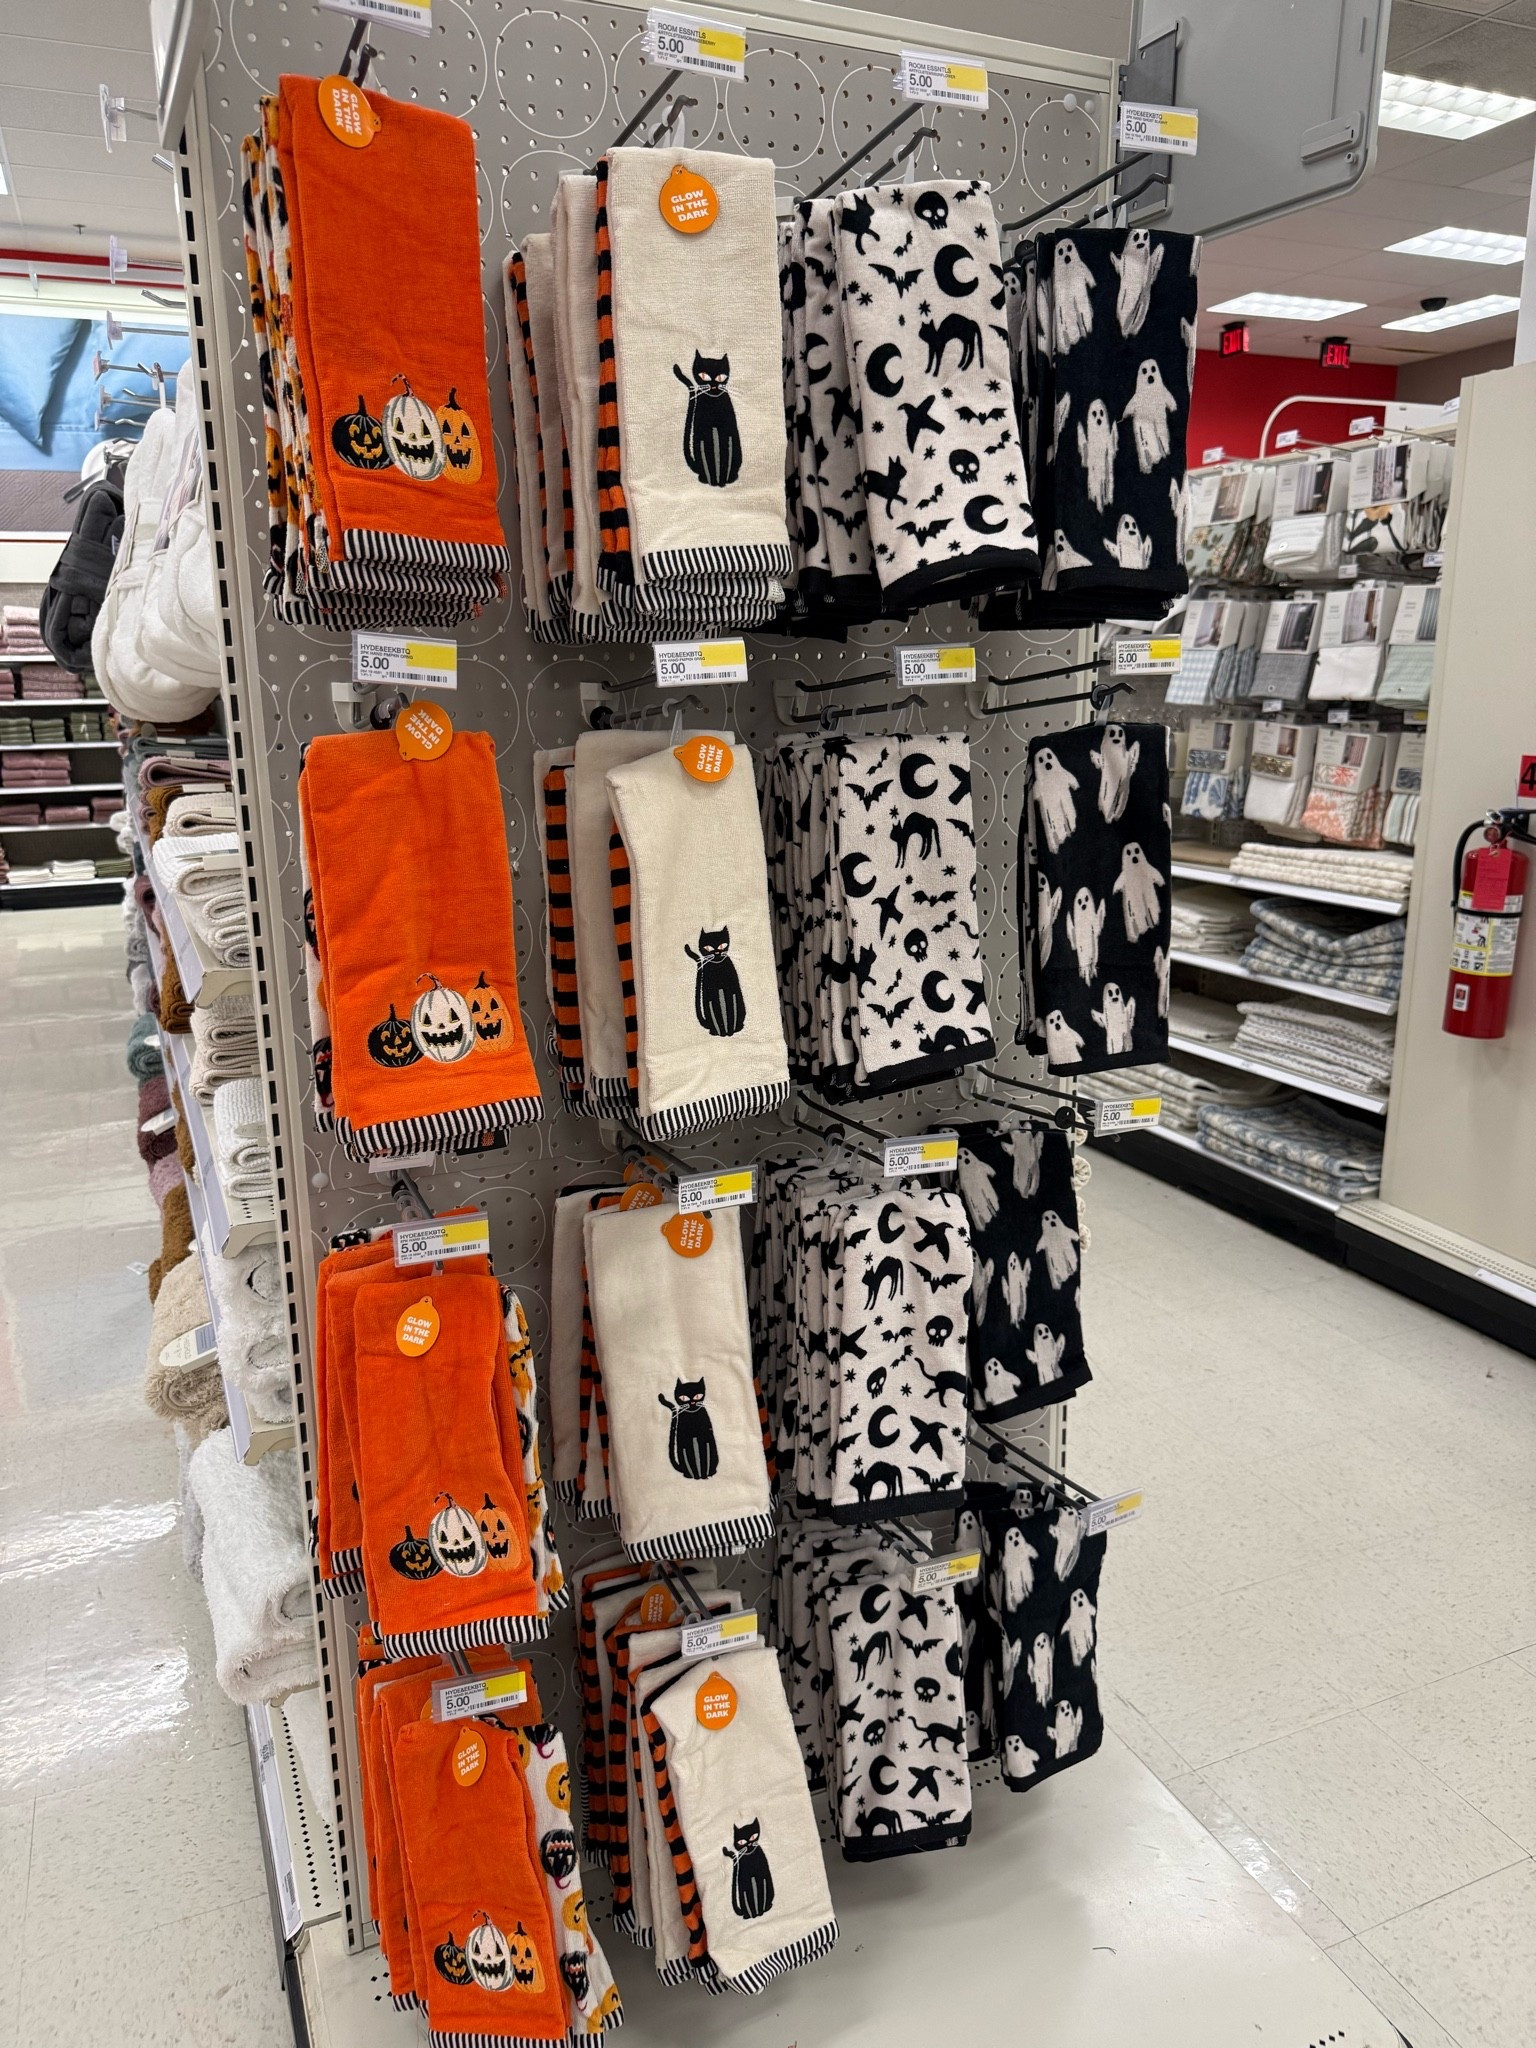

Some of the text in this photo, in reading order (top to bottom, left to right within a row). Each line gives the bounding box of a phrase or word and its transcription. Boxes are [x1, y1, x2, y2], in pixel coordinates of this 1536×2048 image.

[658, 23, 706, 39] ROOM ESSNTLS
[658, 36, 683, 53] 5.00
[927, 65, 951, 74] ESSNTLS
[909, 74, 932, 88] 5.00
[333, 89, 344, 127] DARK
[342, 88, 353, 134] IN THE
[351, 93, 362, 135] GLOW
[1126, 120, 1146, 133] 5.00
[671, 190, 704, 203] GLOW
[672, 199, 709, 213] IN THE
[678, 208, 709, 222] DARK
[1326, 344, 1349, 366] EXIT
[360, 644, 410, 654] HYDE&EEKBTQ
[361, 656, 389, 670] 5.00
[1119, 653, 1137, 663] 5.00
[661, 663, 685, 674] 5.00
[905, 664, 925, 674] 5.00
[418, 709, 444, 735] DARK
[410, 714, 440, 744] IN THE
[405, 723, 432, 749] GLOW
[697, 744, 707, 770] GLOW
[705, 744, 715, 773] IN THE
[714, 749, 723, 772] DARK
[1103, 1112, 1120, 1121] 5.00
[889, 1156, 909, 1166] 5.00
[681, 1191, 702, 1204] 5.00
[400, 1229, 446, 1239] HYDE&EEKBTQ
[681, 1220, 689, 1246] GLOW
[695, 1224, 704, 1248] DARK
[401, 1241, 427, 1253] 5.00
[688, 1240, 693, 1249] IN
[408, 1317, 432, 1328] GLOW
[414, 1327, 430, 1337] THE
[403, 1334, 424, 1345] DARK
[918, 1573, 937, 1583] 5.00
[687, 1636, 707, 1647] 5.00
[446, 1696, 469, 1709] 5.00
[704, 1694, 729, 1702] GLOW
[714, 1701, 730, 1709] THE
[706, 1710, 728, 1719] DARK
[458, 1743, 478, 1759] GLOW
[458, 1751, 480, 1768] IN THE
[461, 1760, 479, 1776] DARK
